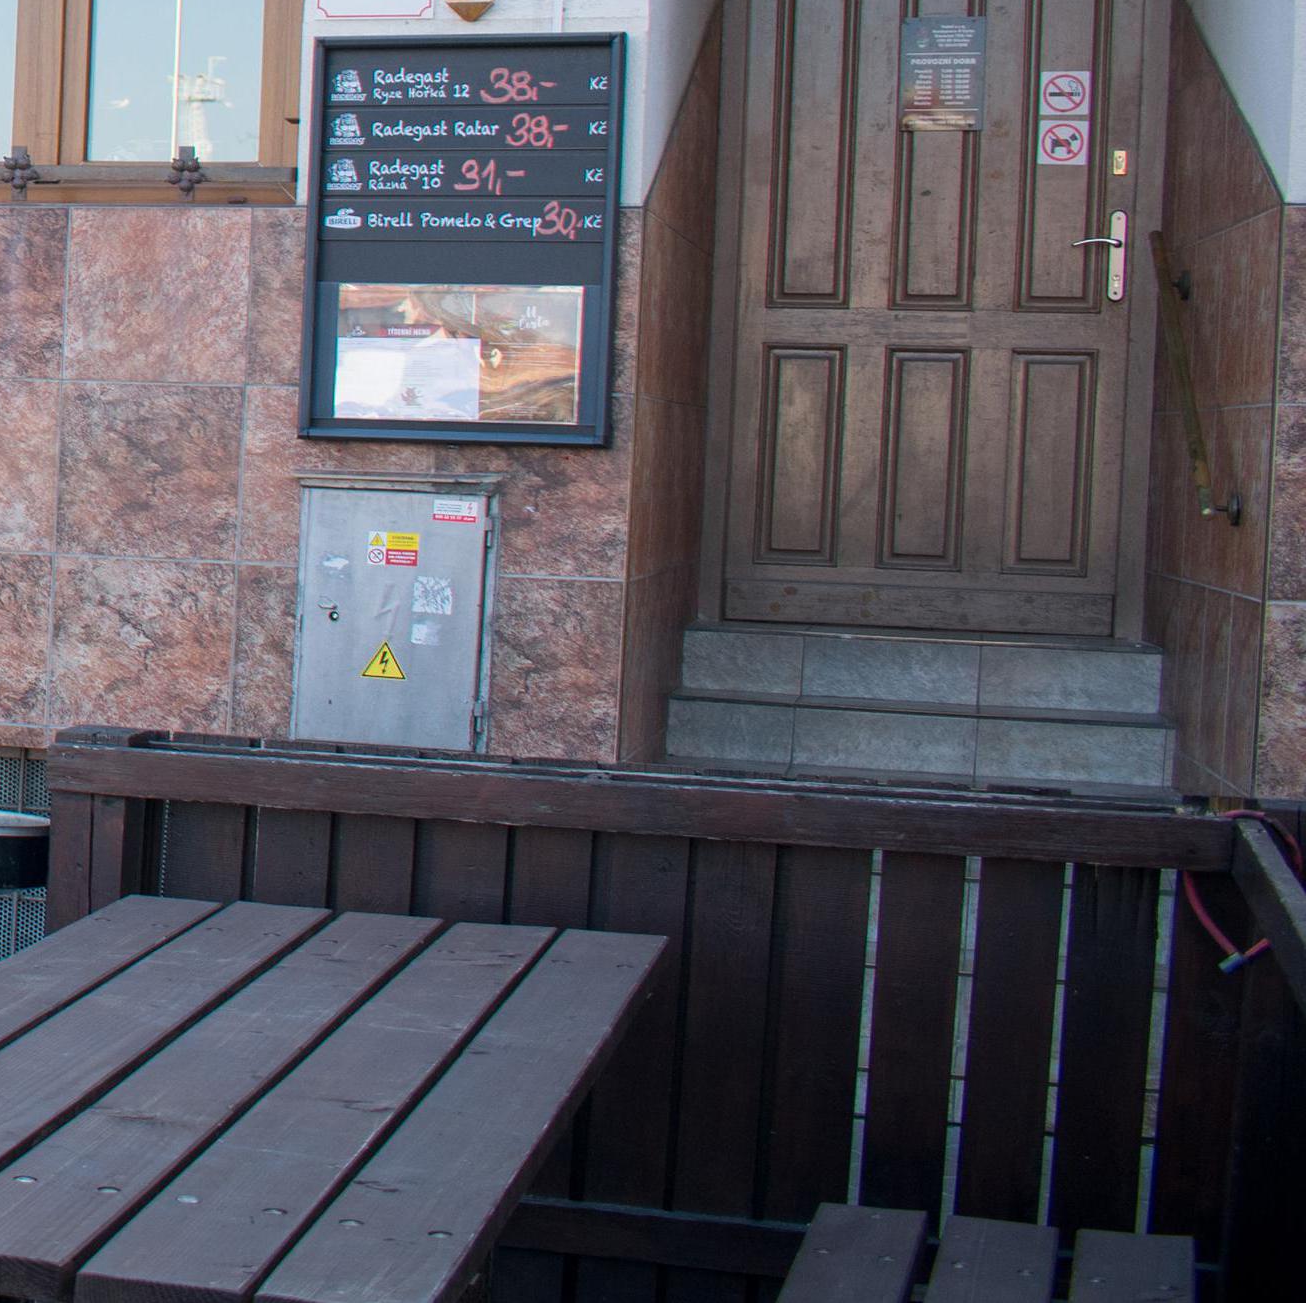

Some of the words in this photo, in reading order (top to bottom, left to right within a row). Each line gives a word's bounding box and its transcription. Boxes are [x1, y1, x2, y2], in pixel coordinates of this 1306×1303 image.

[373, 67, 449, 89] Radegast
[589, 76, 608, 90] Kč
[408, 84, 447, 99] Hořká
[453, 84, 470, 98] 12
[371, 120, 448, 142] Radegast
[454, 121, 500, 137] Ratar
[588, 121, 607, 135] Kč
[368, 158, 445, 180] Radegast
[584, 168, 604, 182] Kč
[368, 177, 408, 191] Rázná
[421, 177, 442, 190] 10
[367, 212, 413, 228] Birell
[420, 212, 481, 228] Pomelo
[483, 213, 496, 229] &
[498, 214, 542, 237] Grep
[584, 215, 603, 229] Kč
